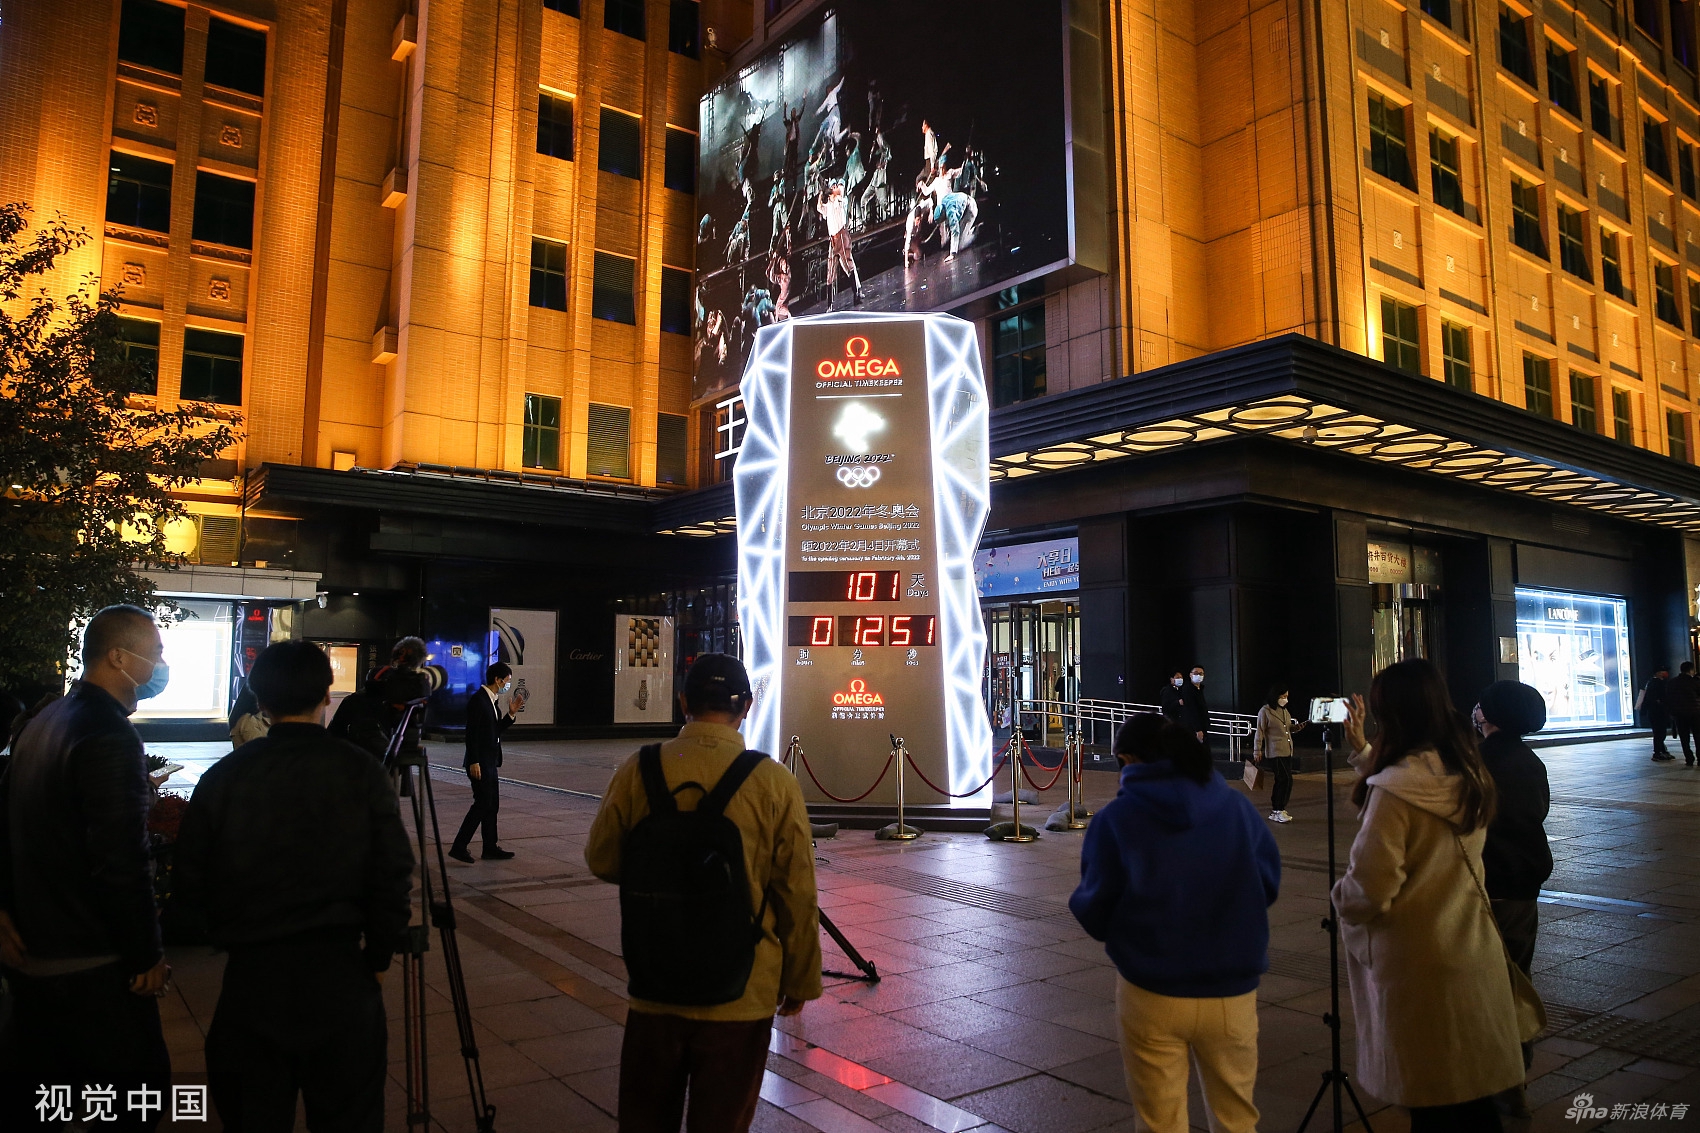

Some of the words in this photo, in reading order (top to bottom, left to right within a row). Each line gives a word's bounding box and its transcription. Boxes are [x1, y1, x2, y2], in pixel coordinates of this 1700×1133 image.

[817, 358, 900, 378] OMEGA
[816, 380, 853, 389] OFFICIAL
[854, 379, 903, 388] TIMEKEEPER
[825, 454, 862, 466] BEIJING
[863, 454, 893, 463] 2022
[801, 503, 920, 520] 北京2022年冬奥会
[801, 523, 830, 532] Olympic
[879, 522, 901, 531] Beijing
[801, 539, 921, 552] 距2022年2月4日开幕式
[1036, 547, 1072, 569] 大享日
[847, 572, 899, 600] 101
[911, 573, 925, 588] 天
[1059, 577, 1072, 585] WITH
[907, 588, 929, 598] Days
[811, 617, 833, 645] 0
[853, 617, 883, 645] 12
[891, 617, 935, 645] 51
[570, 648, 604, 660] Cartier
[799, 649, 810, 659] 时
[853, 649, 863, 659] 分
[906, 648, 917, 659] 秒
[833, 693, 883, 705] OMEGA
